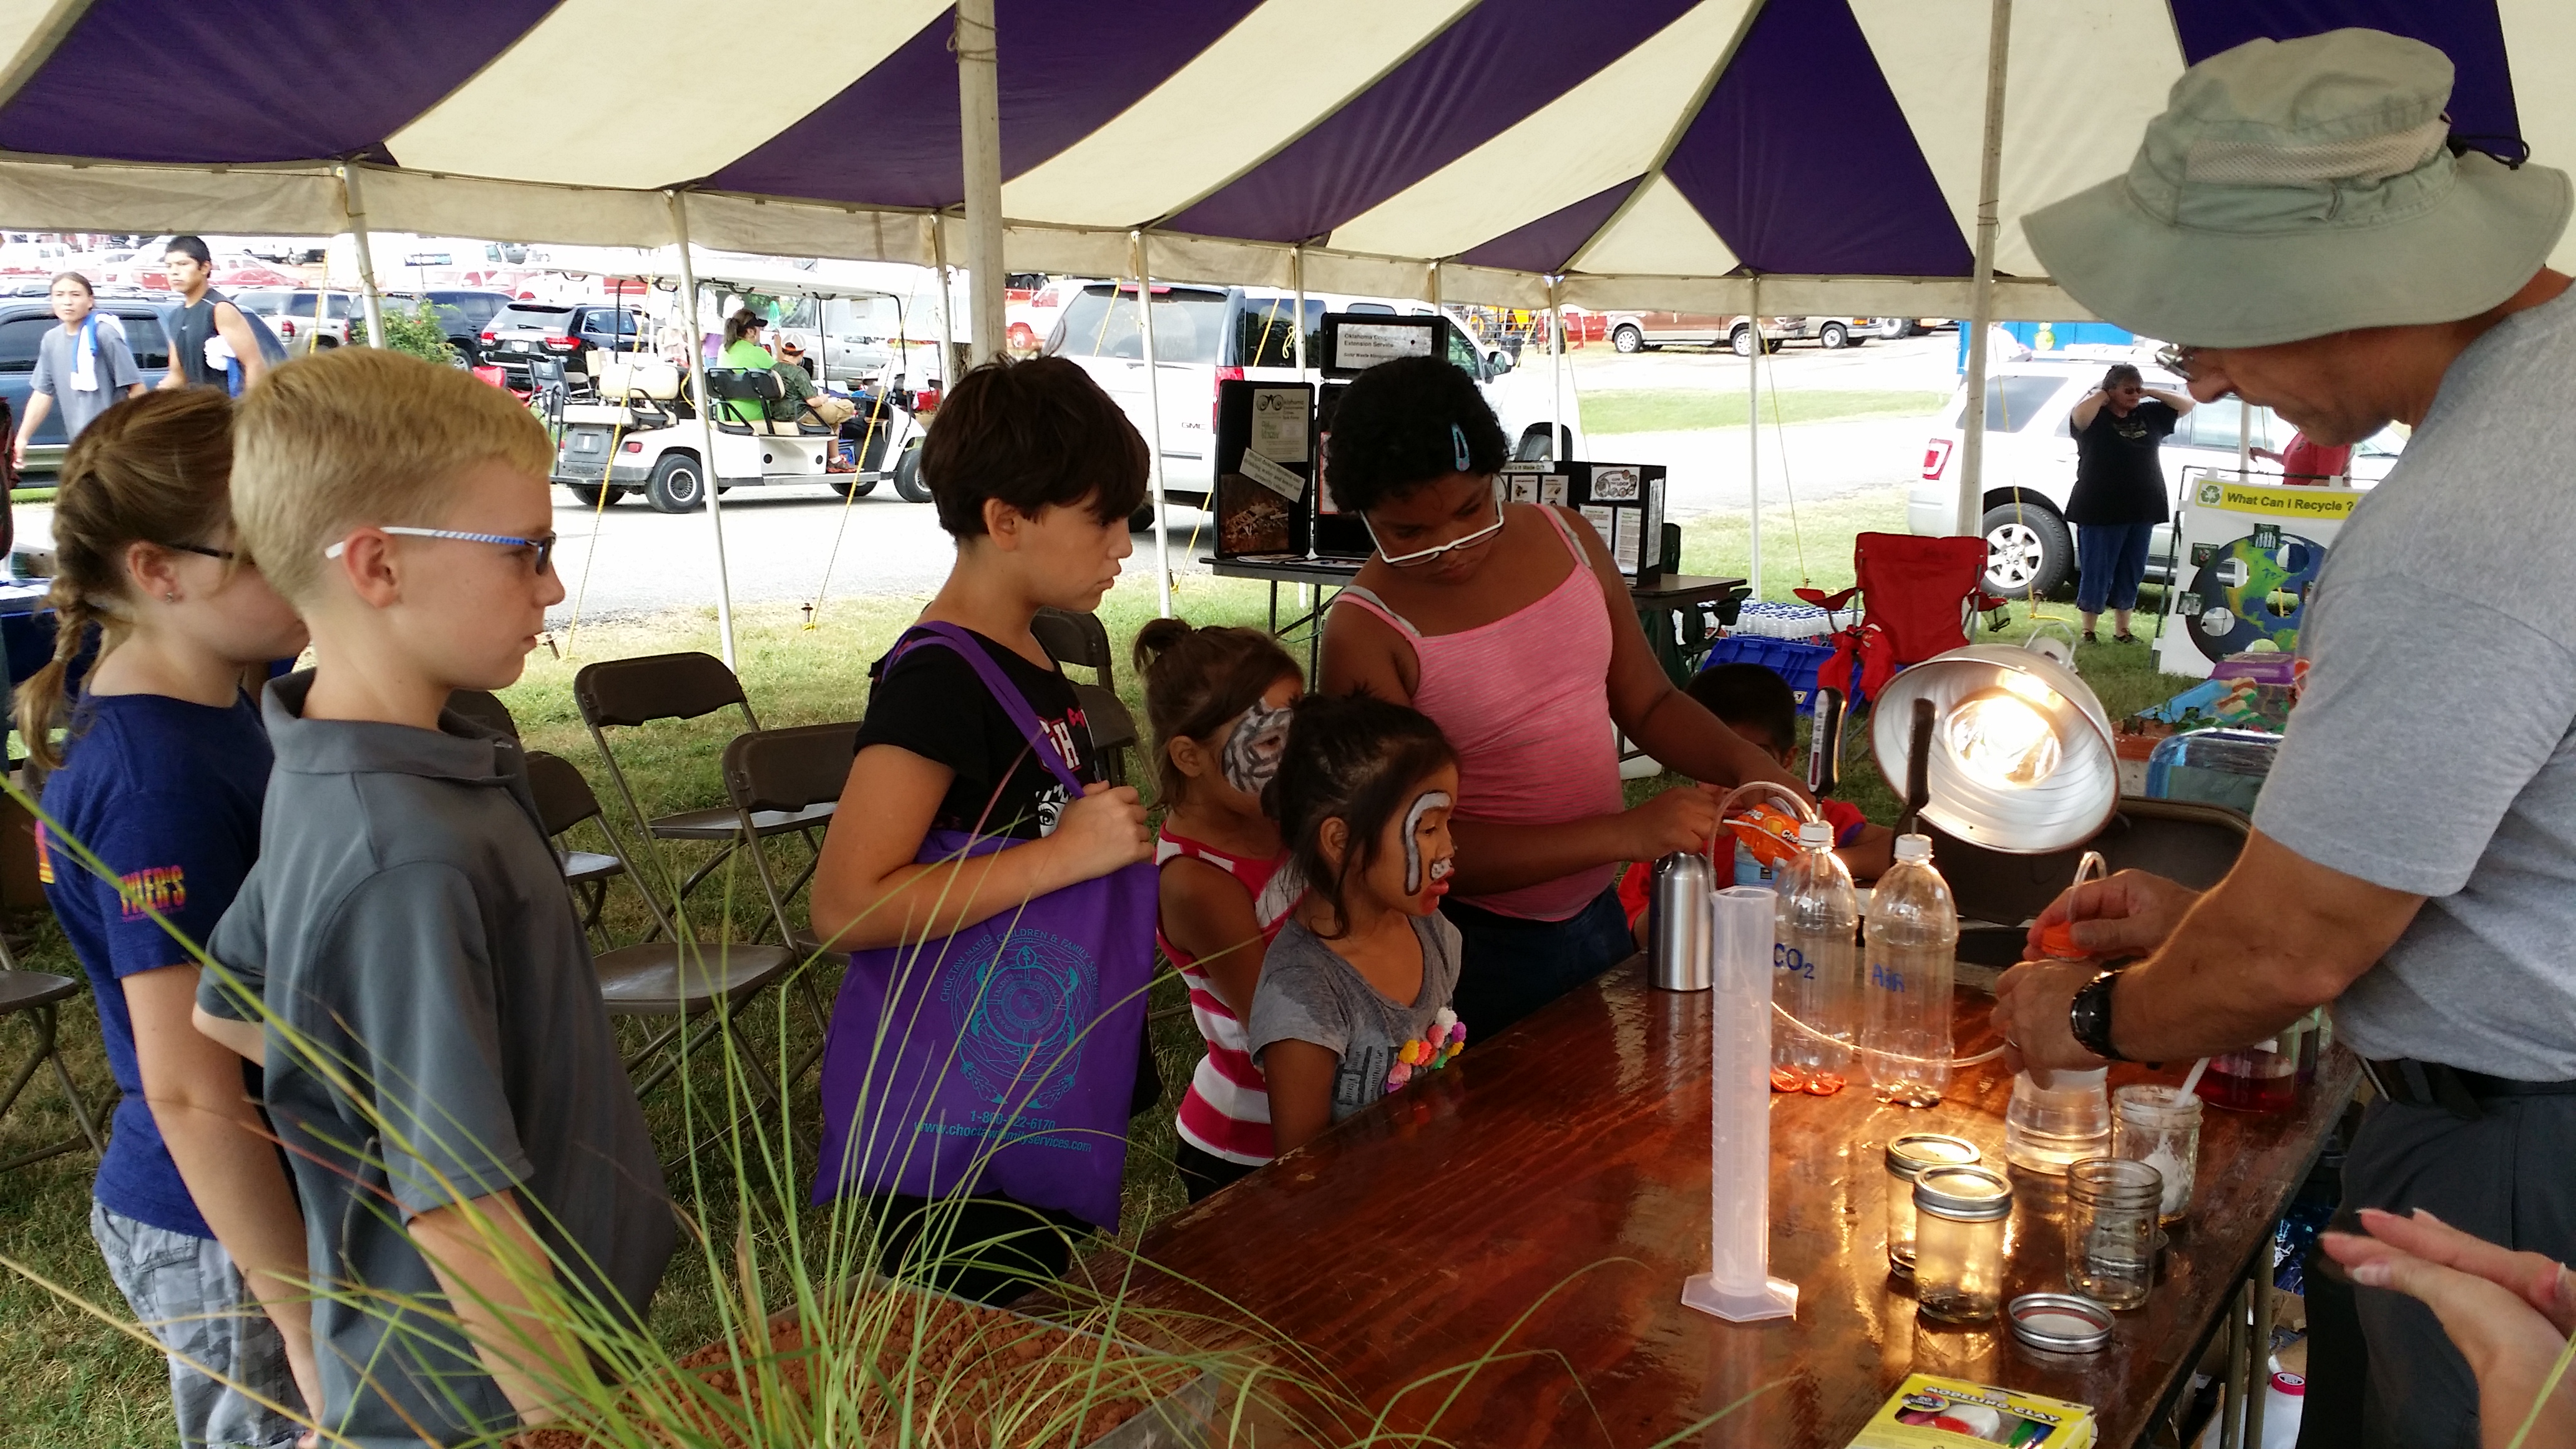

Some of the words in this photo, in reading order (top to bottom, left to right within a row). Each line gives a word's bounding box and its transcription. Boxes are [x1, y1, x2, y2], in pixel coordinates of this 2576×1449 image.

[1181, 422, 1208, 430] GMC
[2227, 492, 2258, 505] What
[2261, 497, 2284, 508] Can
[2287, 498, 2291, 509] I
[2295, 499, 2343, 512] Recycle
[940, 955, 966, 1002] CHOCTAW
[964, 934, 992, 957] NATIO
[1050, 934, 1058, 944] &
[1060, 938, 1092, 960] FAMILY
[1923, 1385, 2011, 1410] MODELING
[2012, 1405, 2062, 1422] CLAY
